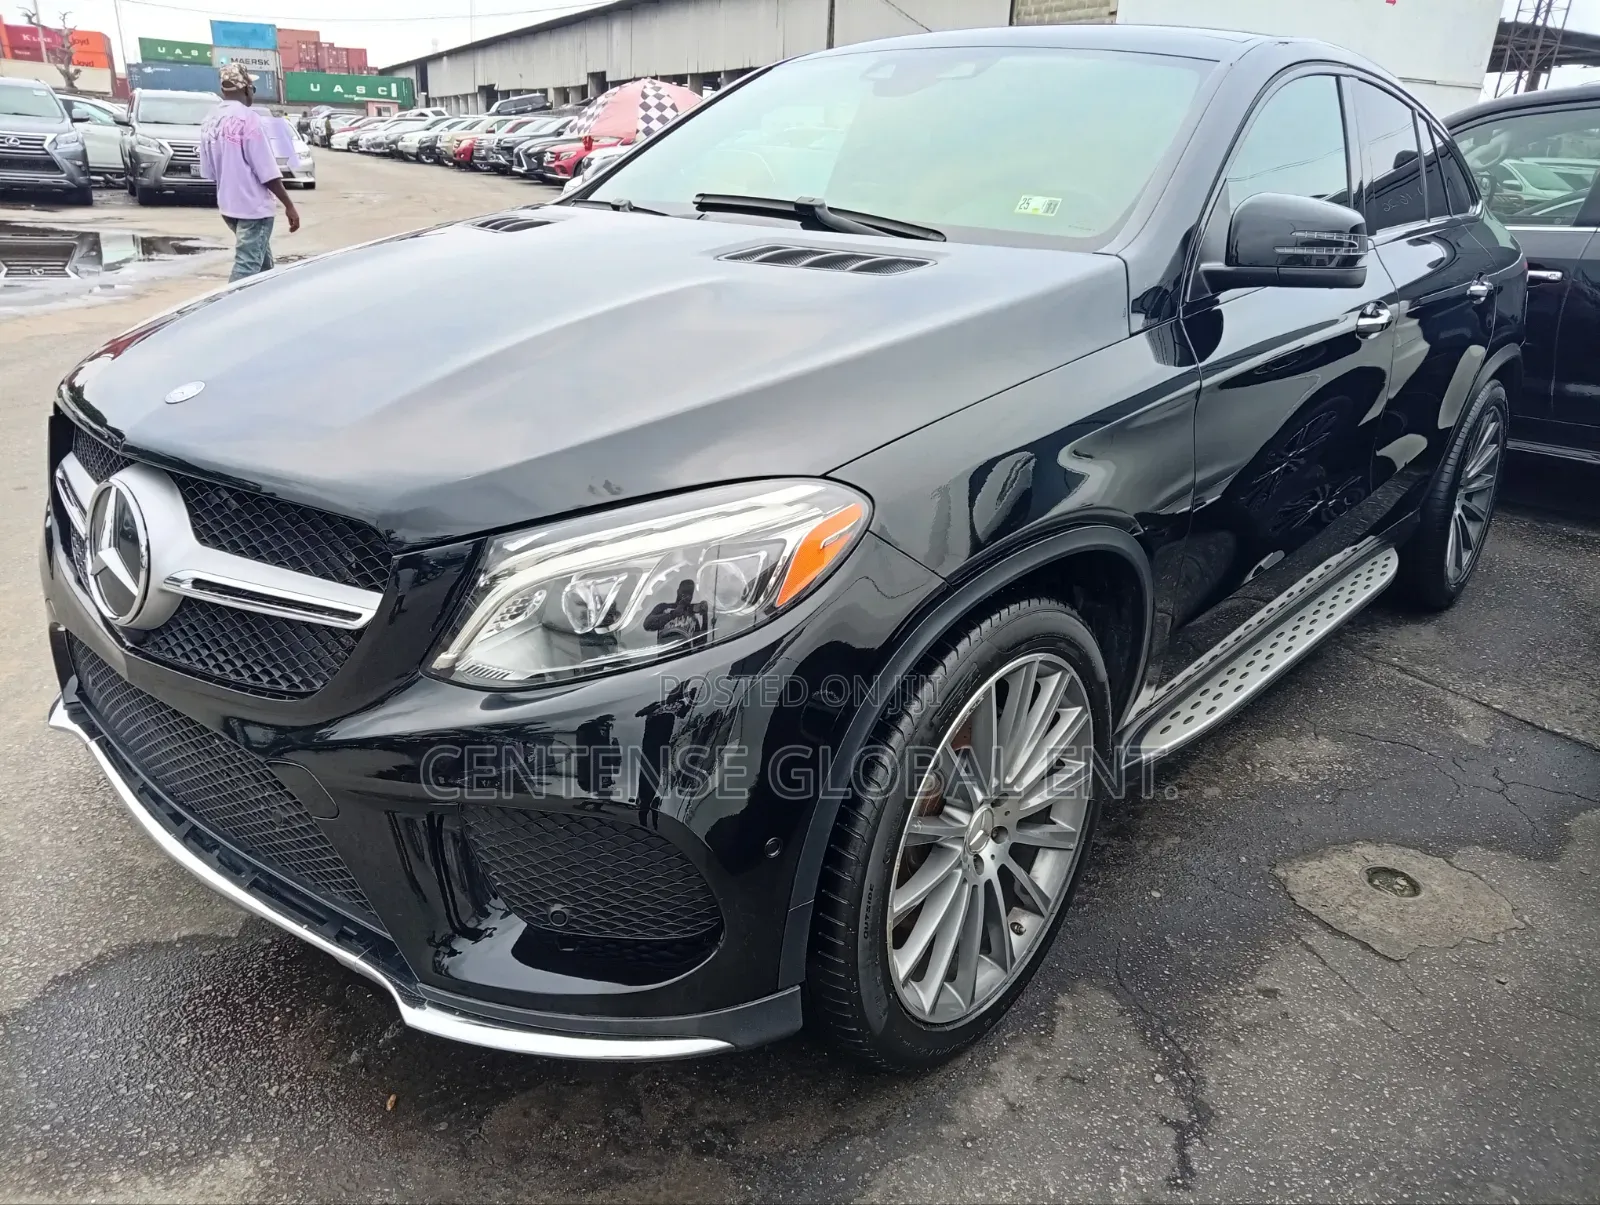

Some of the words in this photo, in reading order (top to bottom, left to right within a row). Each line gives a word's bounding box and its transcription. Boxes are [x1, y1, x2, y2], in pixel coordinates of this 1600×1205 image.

[230, 57, 270, 66] MAERSK
[310, 83, 388, 96] UASC
[863, 883, 874, 940] OUTSIDE
